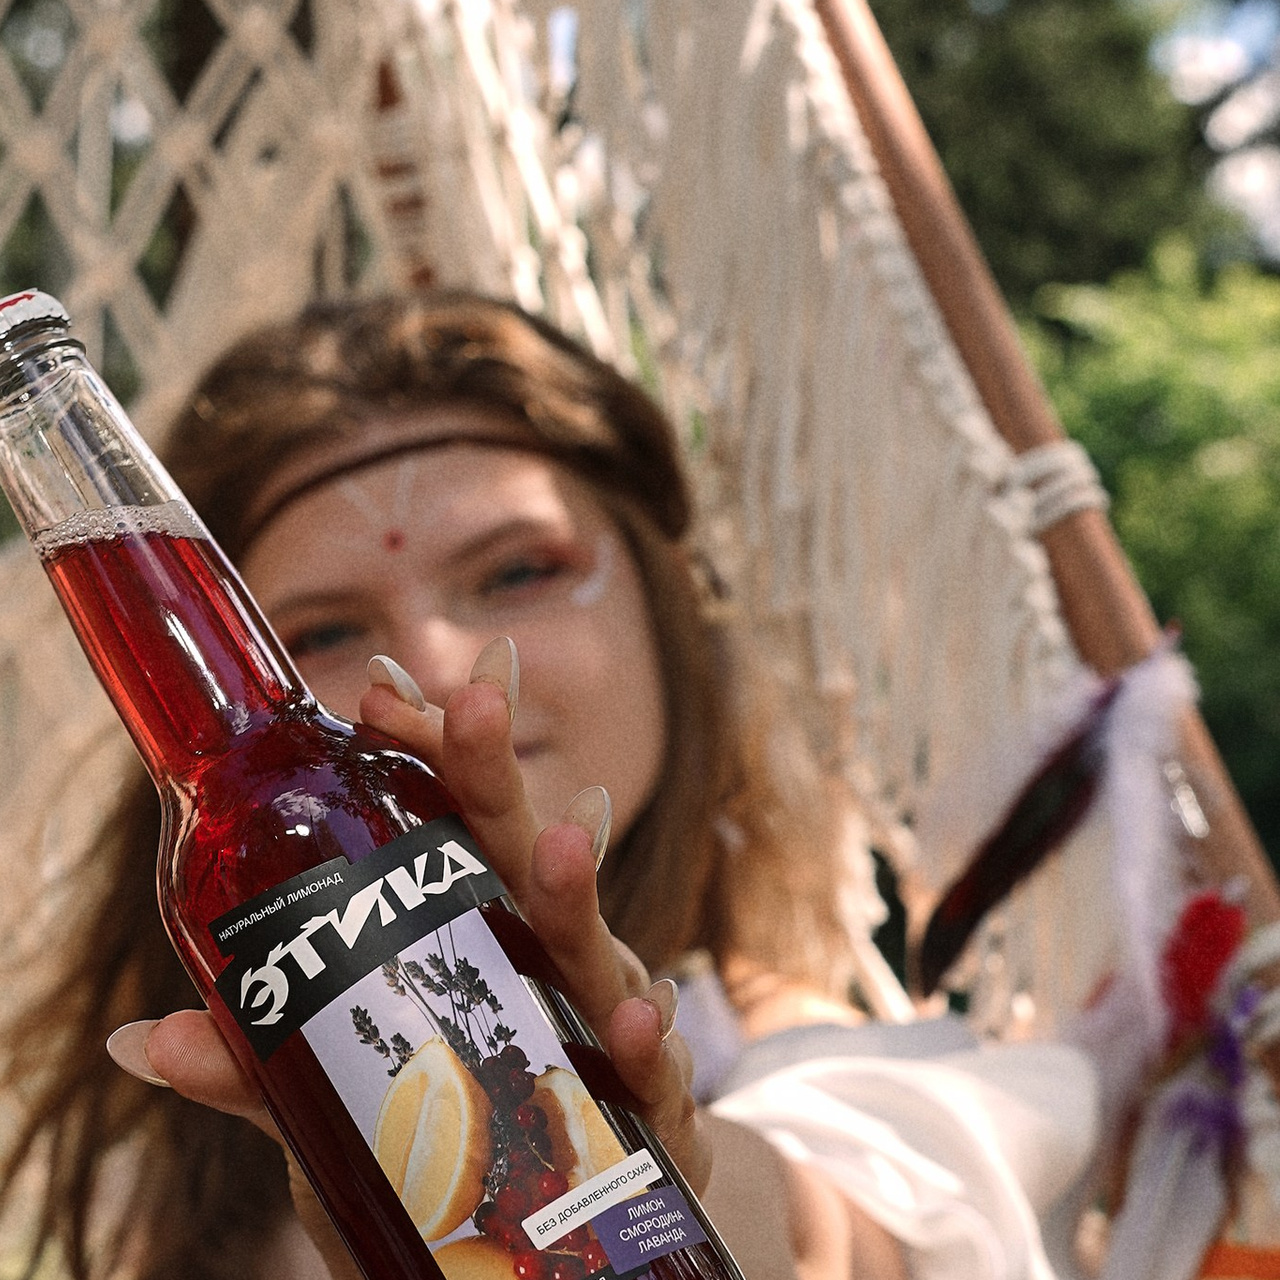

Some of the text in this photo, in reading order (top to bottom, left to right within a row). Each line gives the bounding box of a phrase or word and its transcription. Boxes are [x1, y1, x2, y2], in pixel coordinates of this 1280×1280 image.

[218, 872, 344, 941] НАТУРАЛЬНЫЙ ЛИМОНАД
[240, 840, 487, 1025] ЭТИКА
[536, 1162, 653, 1236] БЕЗ ДОБАВЛЕННОГО САХАРА
[627, 1198, 666, 1220] ЛИМОН
[619, 1210, 685, 1241] СМОРОДИНА
[638, 1227, 687, 1253] ЛАВАНДА
